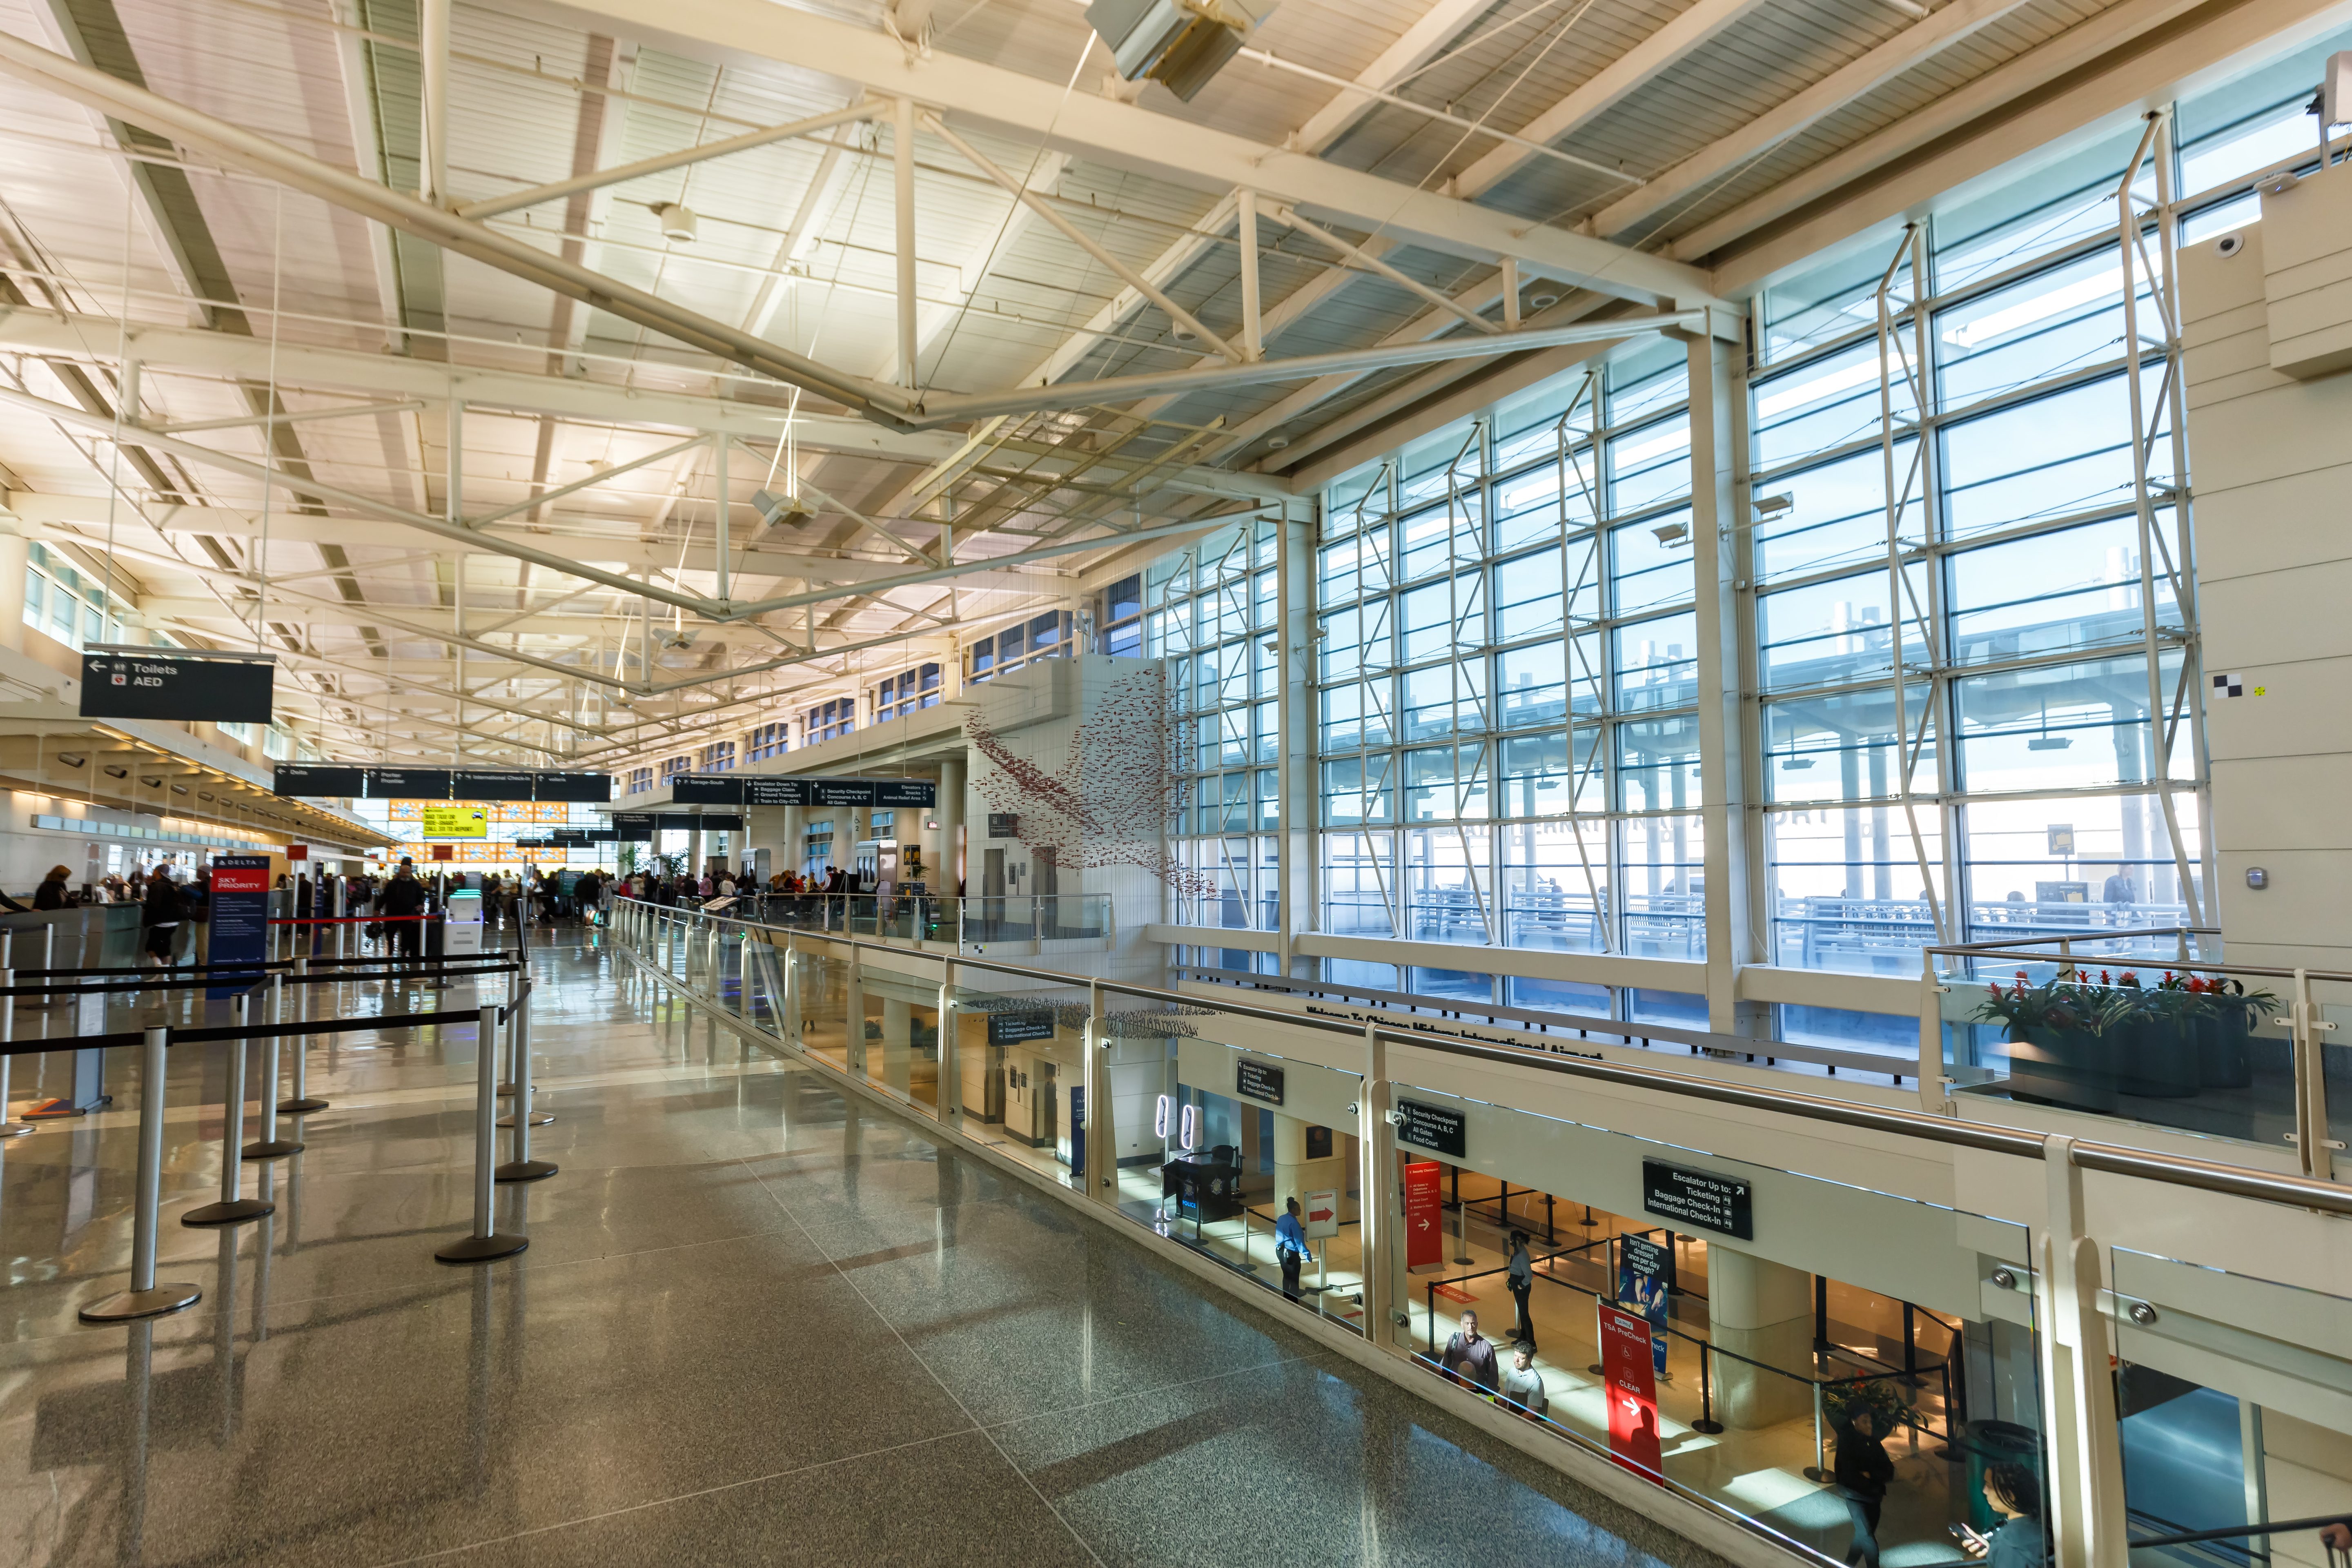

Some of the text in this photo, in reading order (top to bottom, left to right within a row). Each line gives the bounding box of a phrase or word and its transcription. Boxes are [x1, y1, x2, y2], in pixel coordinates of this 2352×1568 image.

[132, 663, 178, 675] Toilets
[133, 677, 163, 687] AED
[1243, 1064, 1257, 1072] Escalator
[1247, 1072, 1261, 1082] Ticketing
[1247, 1079, 1275, 1092] Baggage Check-In
[1247, 1086, 1265, 1096] International
[1413, 1109, 1458, 1126] Security Checkpoint
[1413, 1118, 1437, 1129] Concourse
[1419, 1128, 1433, 1137] Gates
[1413, 1135, 1438, 1147] Food Court
[1673, 1172, 1731, 1194] Escalator Up to:
[1655, 1189, 1720, 1214] Baggage Check-In
[1686, 1187, 1720, 1204] Ticketing
[1182, 1199, 1196, 1209] POLICE
[1648, 1198, 1721, 1225] International Check-In
[1630, 1238, 1659, 1255] Isn't getting
[1634, 1247, 1653, 1260] dressed
[1628, 1253, 1639, 1262] once
[1650, 1261, 1660, 1270] day
[1633, 1262, 1655, 1275] enough?
[1604, 1322, 1646, 1344] TSA PreCheck
[1619, 1379, 1640, 1394] CLEAR
